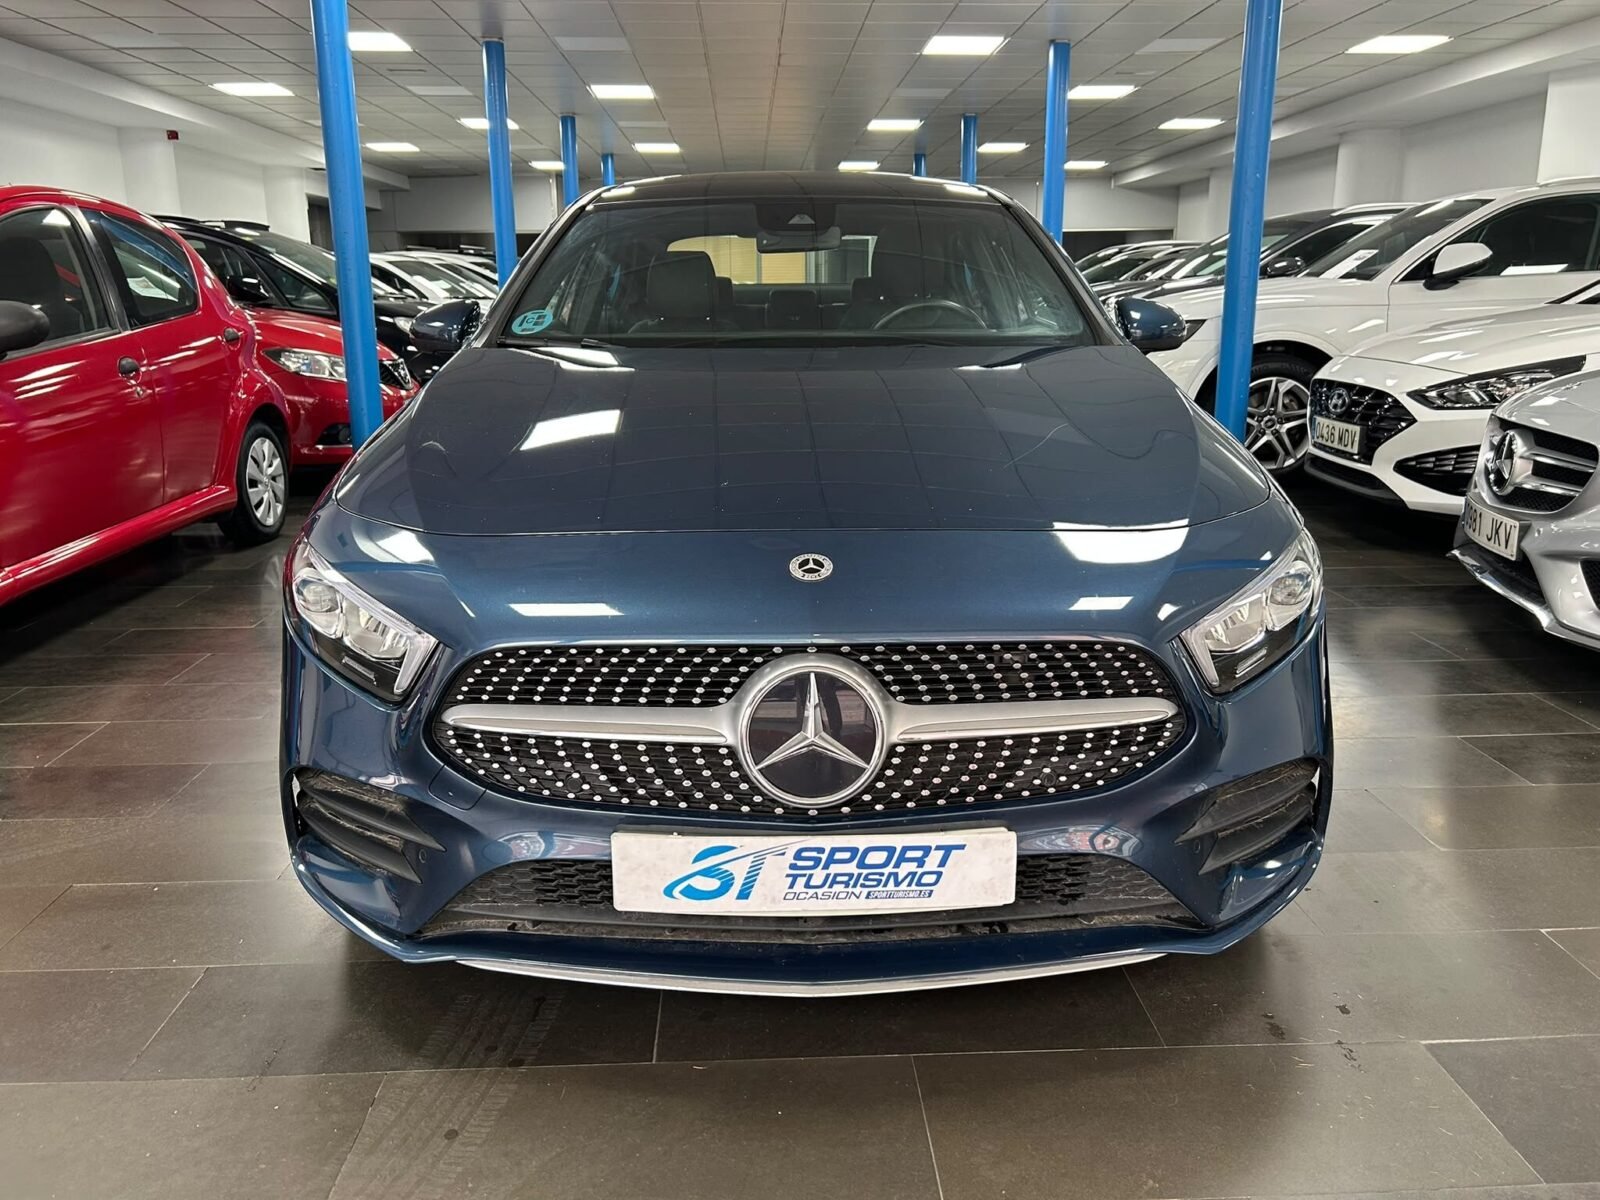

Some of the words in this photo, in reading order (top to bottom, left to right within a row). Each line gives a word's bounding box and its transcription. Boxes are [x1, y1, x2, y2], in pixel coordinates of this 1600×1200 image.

[1315, 422, 1336, 444] 0436
[1486, 517, 1513, 550] JKV
[788, 843, 967, 871] SPORT
[784, 870, 944, 890] TURISMO
[783, 890, 863, 901] OCASION
[867, 889, 932, 900] SPORTTURISMO.ES
